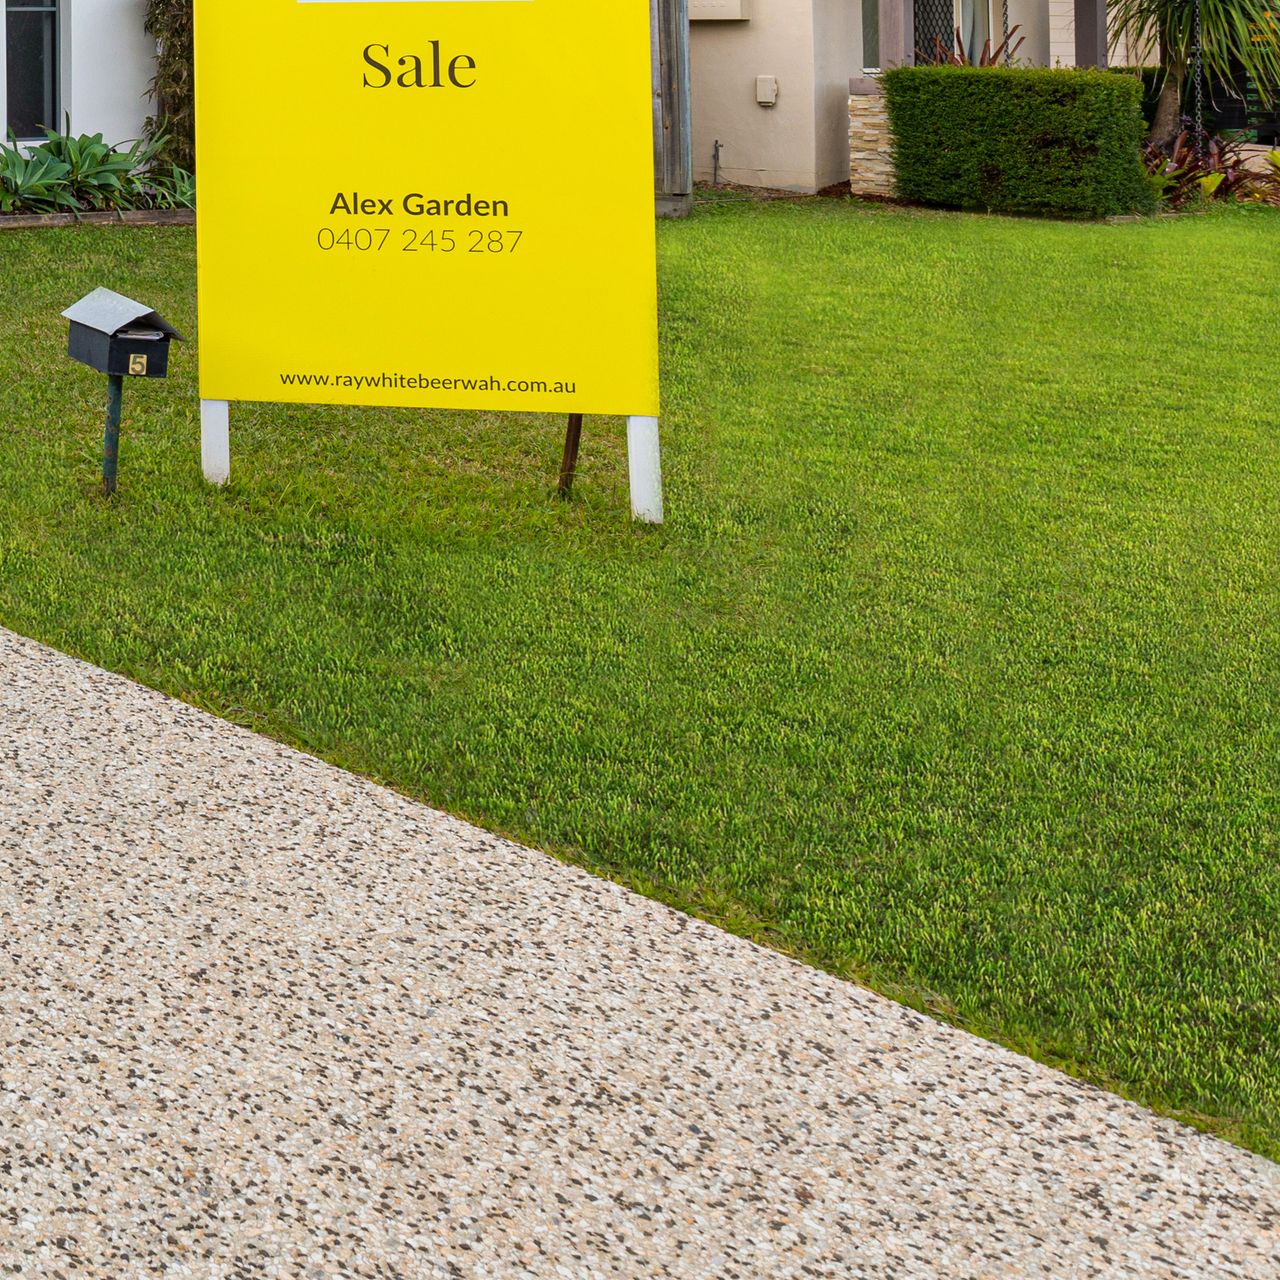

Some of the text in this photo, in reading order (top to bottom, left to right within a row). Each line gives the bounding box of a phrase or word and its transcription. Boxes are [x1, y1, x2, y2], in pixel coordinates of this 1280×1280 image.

[363, 40, 476, 88] Sale
[330, 192, 508, 216] Alex Garden
[317, 228, 523, 253] 0407 245 287
[130, 355, 145, 374] 5
[280, 371, 576, 394] www.raywhitebeerwah.com.au
